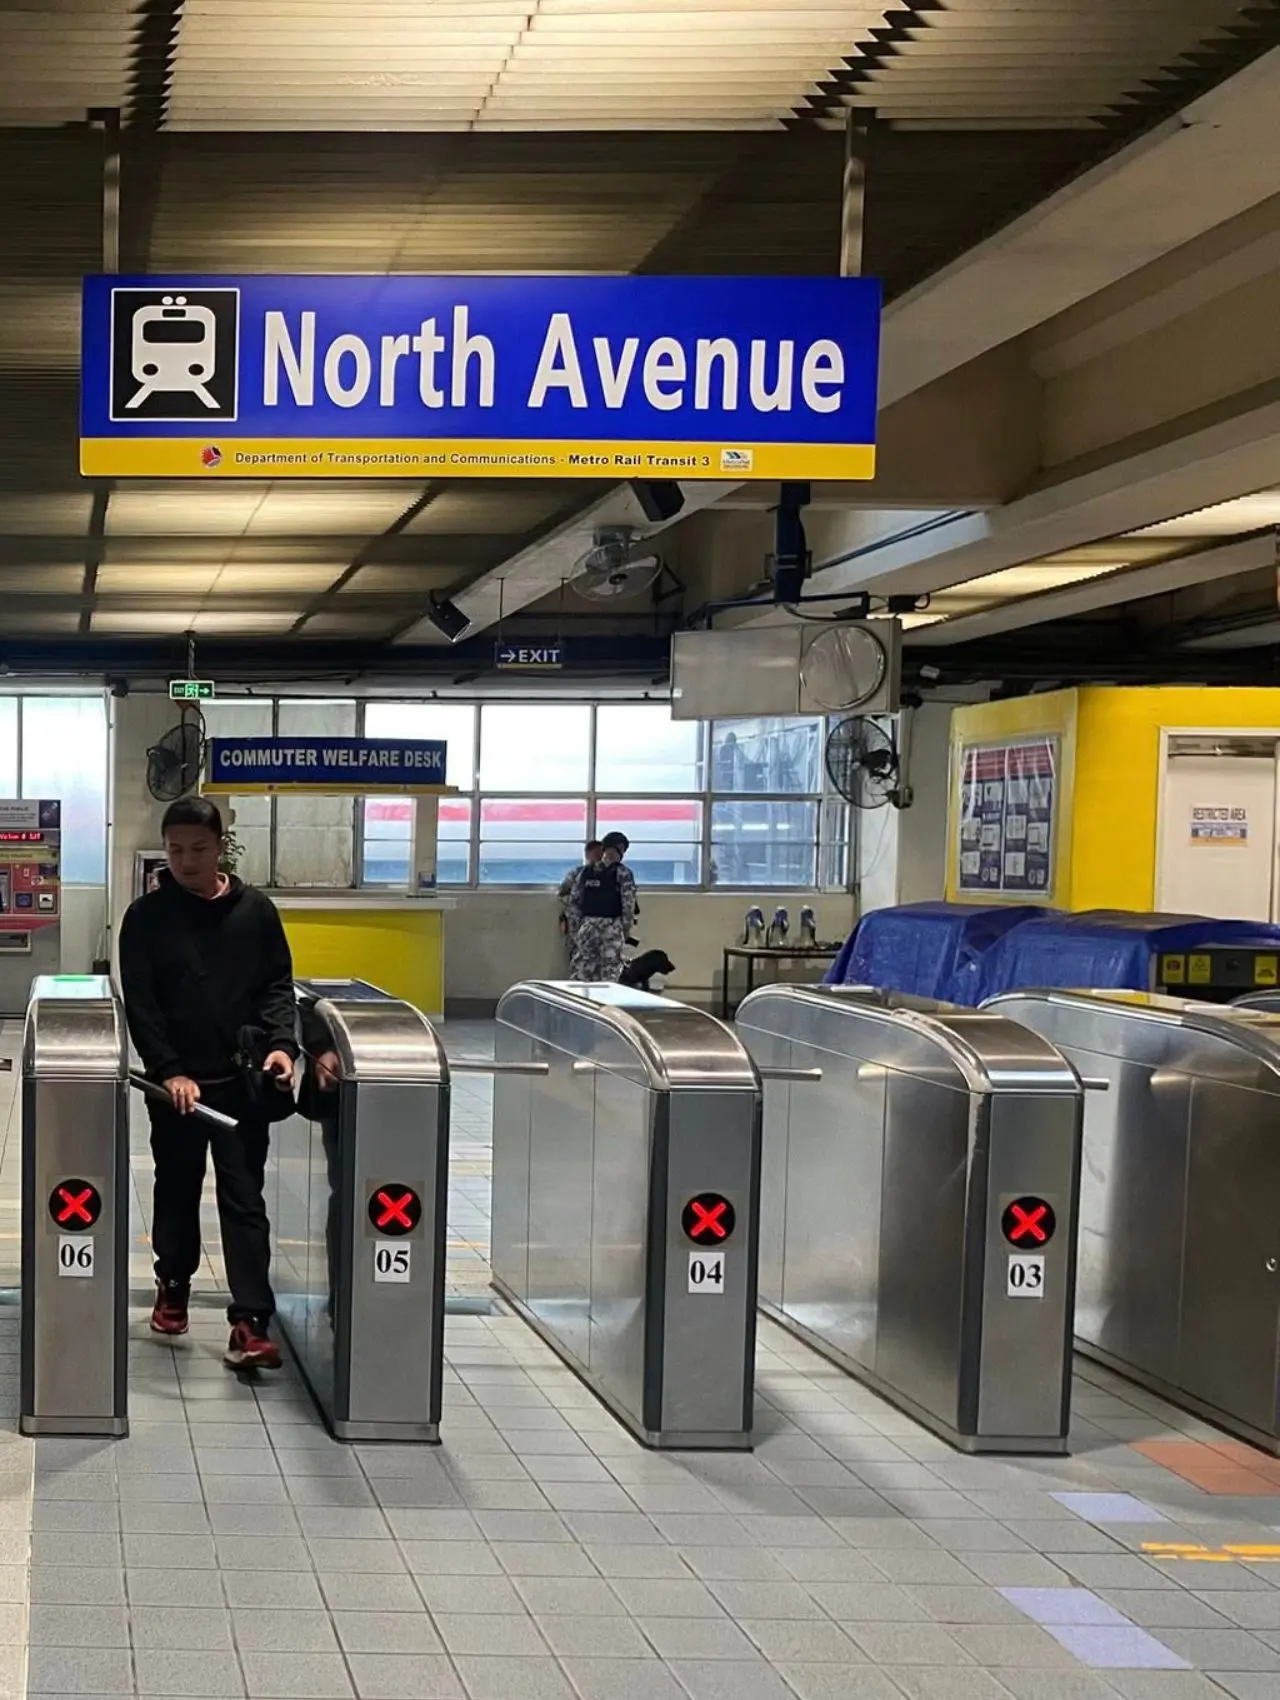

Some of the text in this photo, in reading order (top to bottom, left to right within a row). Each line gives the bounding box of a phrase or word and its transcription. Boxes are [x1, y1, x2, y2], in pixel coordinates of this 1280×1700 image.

[264, 306, 845, 412] North Avenue
[235, 452, 307, 466] Department
[311, 452, 323, 464] of
[328, 452, 419, 466] Transportation
[423, 453, 446, 464] and
[450, 453, 556, 465] Communications
[569, 454, 609, 465] Metro
[614, 454, 641, 465] Rail
[647, 454, 697, 466] Transit
[701, 455, 710, 466] 3
[518, 649, 560, 663] EXIT
[220, 749, 441, 768] COMMUTER WELFARE DESK
[60, 1243, 92, 1268] 06
[376, 1248, 409, 1274] 05
[690, 1260, 723, 1284] 04
[1009, 1263, 1042, 1288] 03
